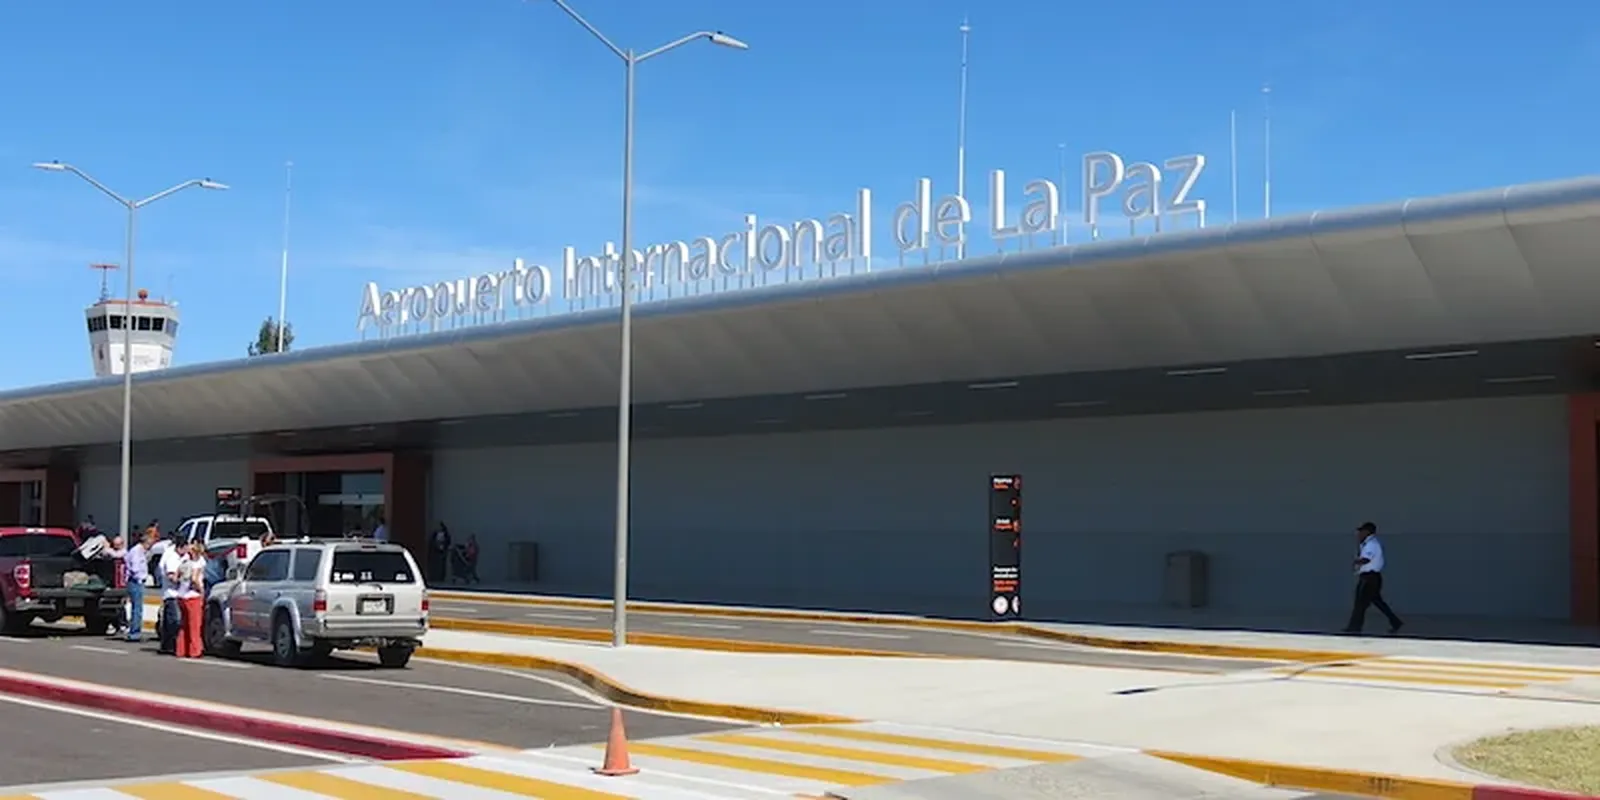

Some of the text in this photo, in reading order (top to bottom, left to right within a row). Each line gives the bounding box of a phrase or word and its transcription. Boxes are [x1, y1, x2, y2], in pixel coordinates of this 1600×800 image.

[358, 151, 1206, 331] Aeropuerto Internacional de La Paz
